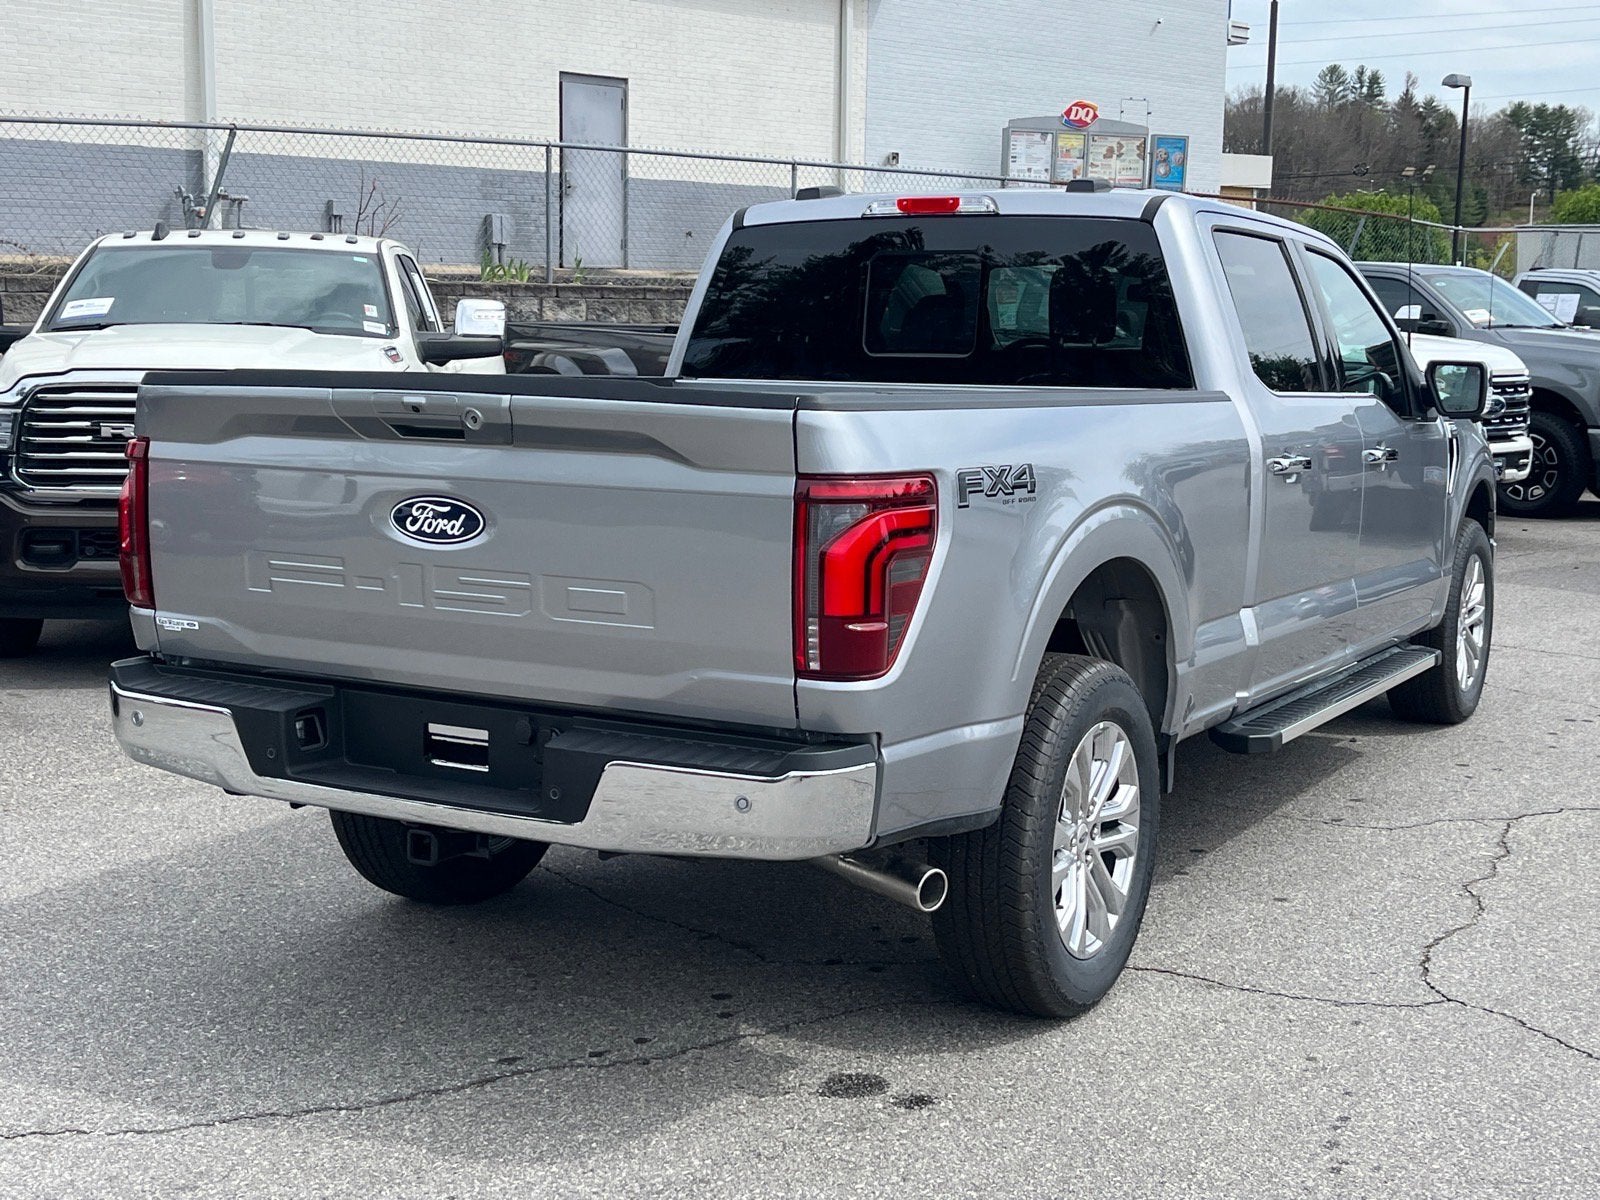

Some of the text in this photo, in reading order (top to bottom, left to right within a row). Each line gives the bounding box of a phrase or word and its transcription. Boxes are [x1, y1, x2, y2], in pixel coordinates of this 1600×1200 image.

[1069, 106, 1094, 124] DQ
[956, 463, 1036, 509] FX4
[1002, 496, 1037, 506] OFF ROAD
[405, 502, 466, 536] Ford
[244, 549, 656, 630] F-150
